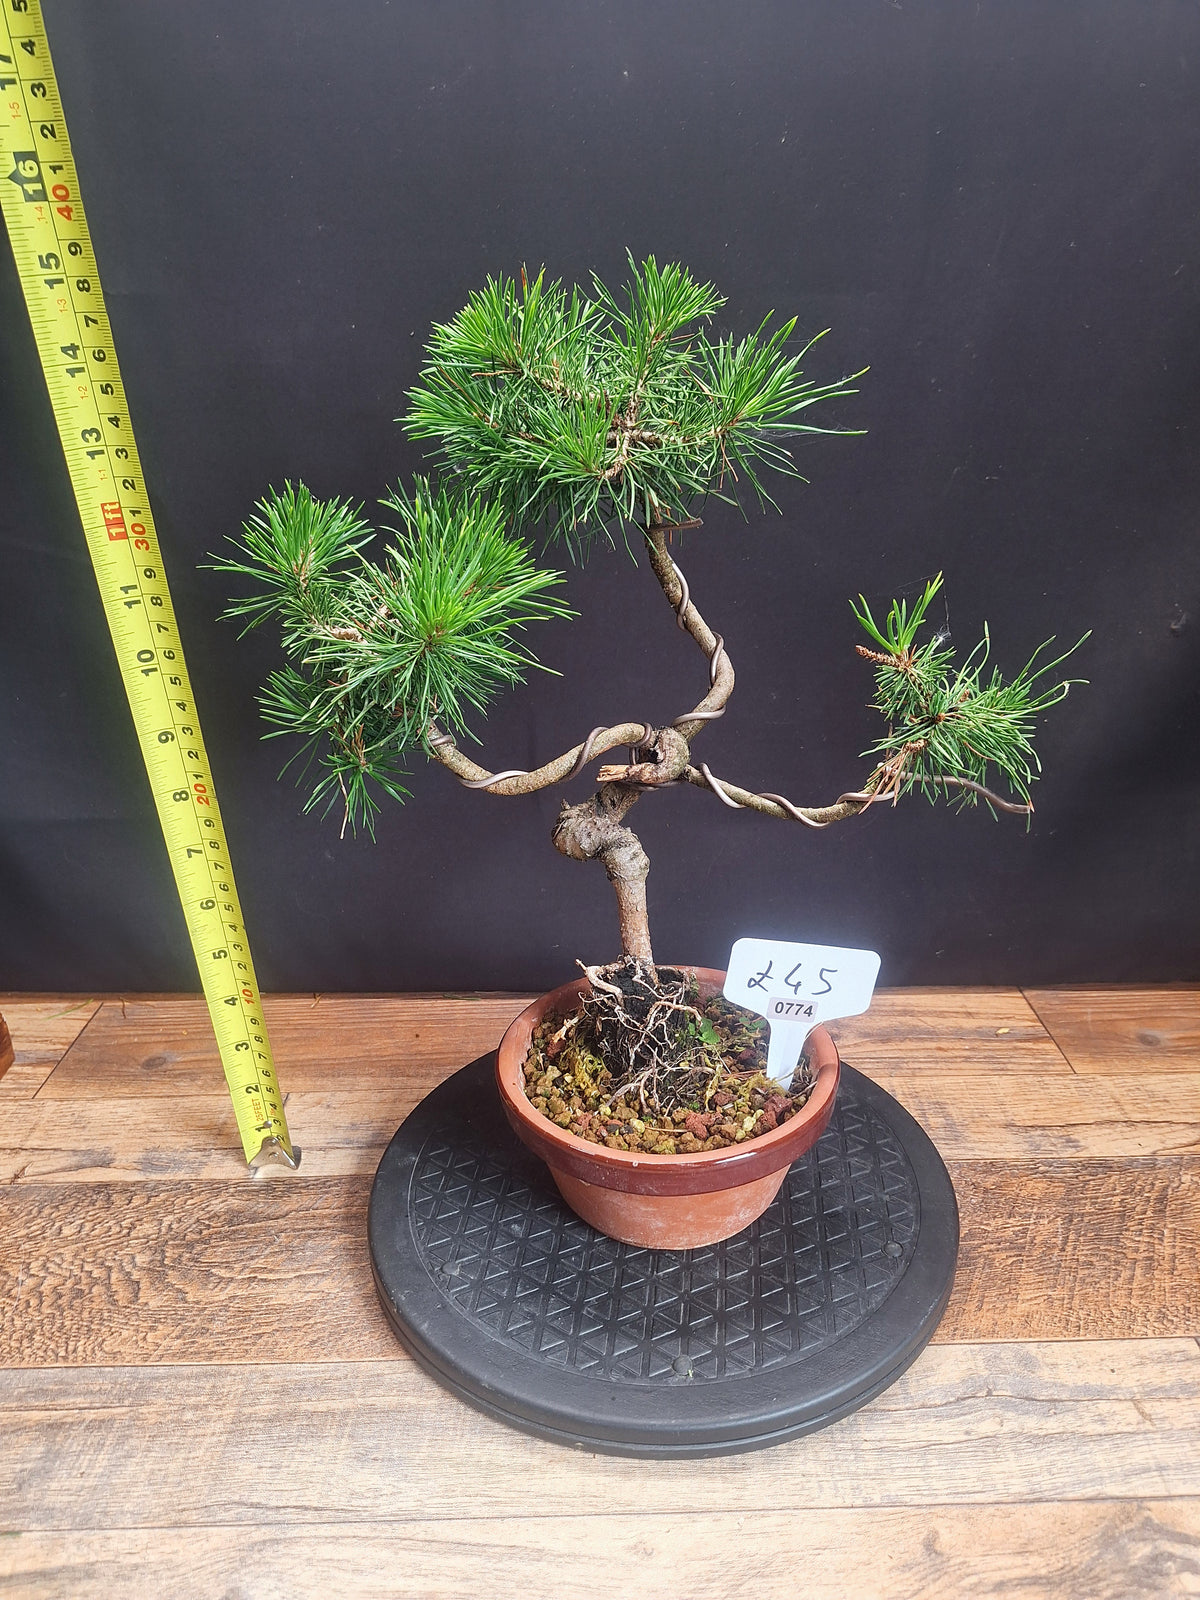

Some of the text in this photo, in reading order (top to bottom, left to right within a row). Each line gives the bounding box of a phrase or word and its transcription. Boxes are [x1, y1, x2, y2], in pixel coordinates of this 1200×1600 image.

[12, 0, 28, 12] 5
[20, 39, 36, 56] 4
[31, 82, 46, 98] 3
[40, 123, 56, 139] 2
[49, 165, 64, 174] 1
[18, 160, 43, 195] 16
[52, 184, 73, 221] 40
[68, 242, 82, 256] 9
[38, 252, 64, 289] 15
[76, 279, 90, 292] 8
[84, 315, 98, 328] 7
[60, 343, 86, 378] 14
[92, 349, 106, 362] 6
[100, 383, 114, 396] 5
[108, 416, 120, 428] 4
[81, 428, 105, 460] 13
[115, 448, 128, 460] 3
[122, 479, 136, 490] 2
[130, 523, 150, 551] 30
[144, 568, 156, 579] 9
[120, 584, 142, 608] 11
[150, 596, 163, 606] 8
[157, 624, 169, 633] 7
[164, 650, 175, 660] 6
[137, 650, 158, 676] 10
[170, 676, 182, 686] 5
[176, 702, 188, 712] 4
[182, 726, 194, 736] 3
[158, 731, 175, 744] 9
[188, 750, 199, 760] 2
[172, 790, 190, 802] 8
[194, 784, 210, 806] 20
[204, 819, 214, 828] 9
[210, 841, 220, 850] 8
[187, 848, 203, 858] 7
[218, 884, 230, 892] 6
[200, 900, 216, 910] 6
[224, 904, 234, 912] 5
[228, 924, 238, 932] 4
[233, 944, 243, 952] 3
[212, 950, 228, 960] 5
[238, 962, 248, 970] 2
[747, 960, 838, 996] £45
[224, 997, 238, 1006] 4
[242, 989, 254, 1004] 10
[774, 1002, 814, 1017] 0774
[235, 1042, 249, 1052] 3
[246, 1085, 260, 1094] 2
